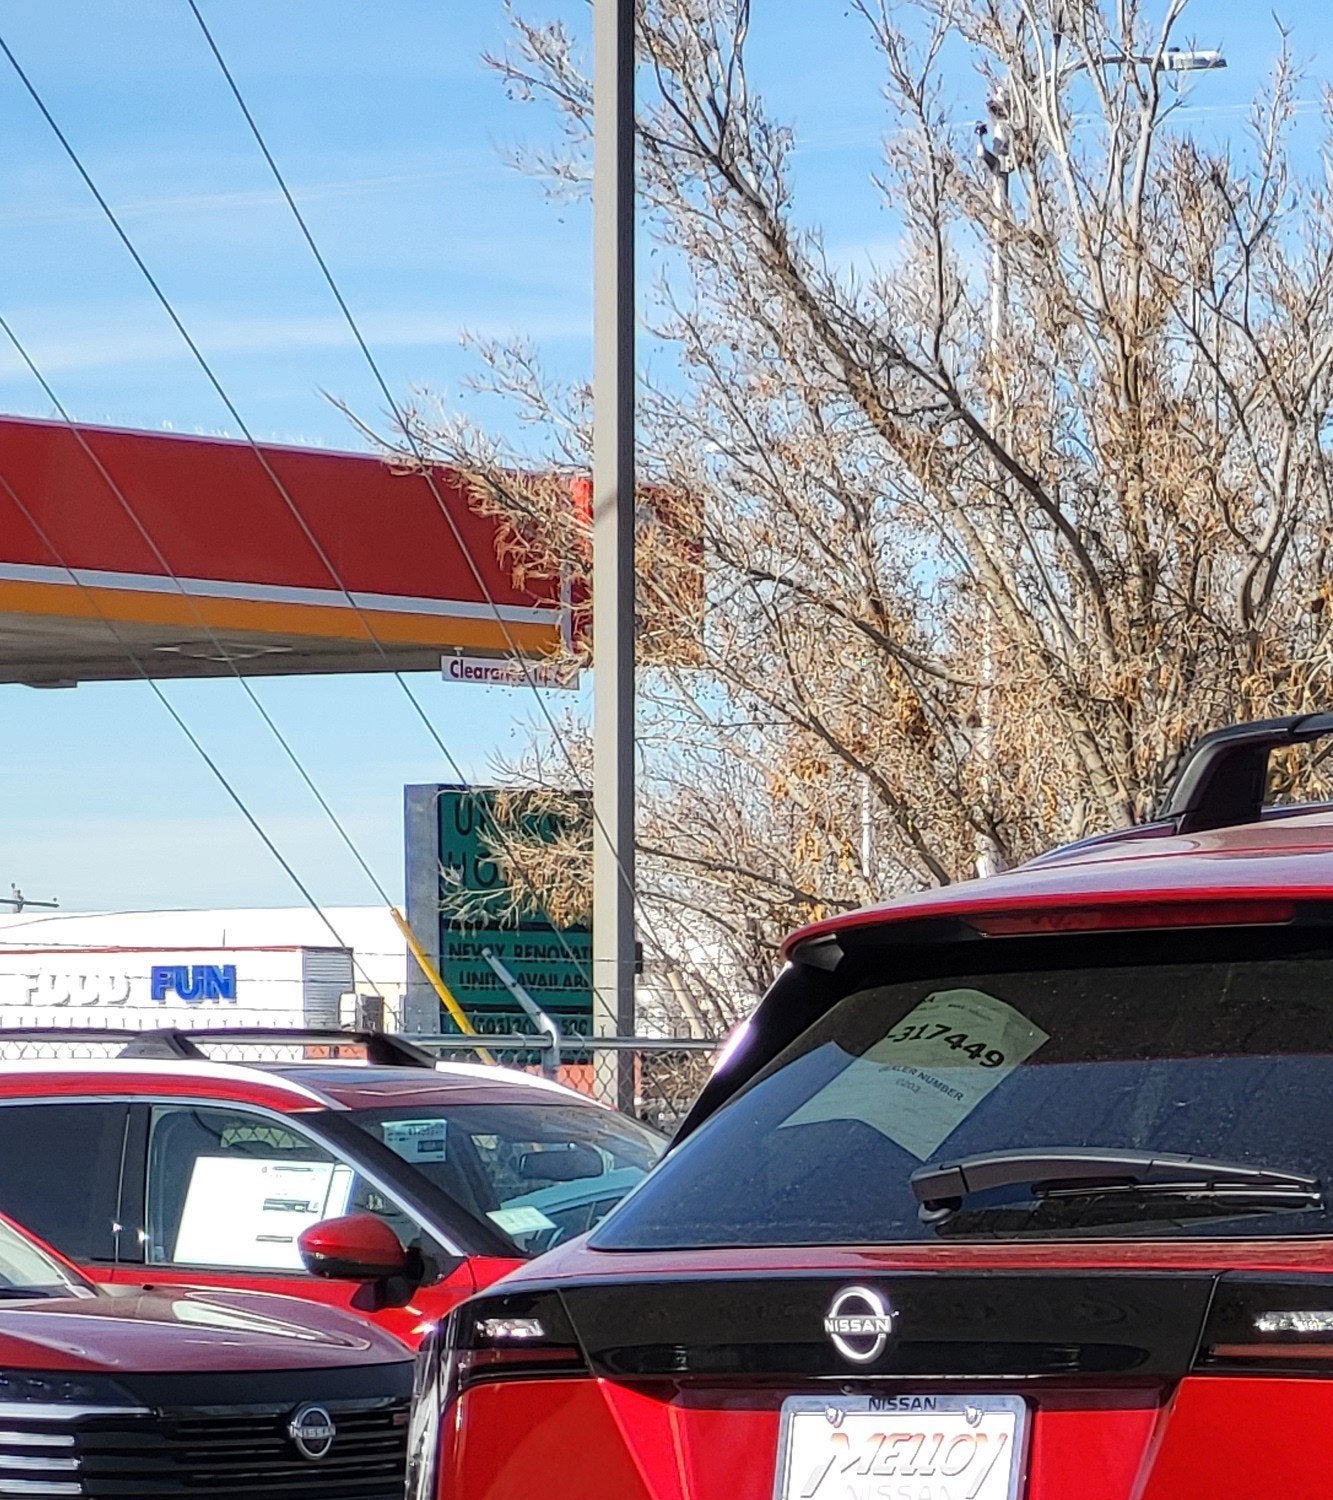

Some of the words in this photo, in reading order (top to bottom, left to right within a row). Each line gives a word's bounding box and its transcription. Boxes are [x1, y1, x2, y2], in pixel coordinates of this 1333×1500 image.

[449, 942, 506, 962] NEWY
[513, 943, 592, 964] RENOVAT
[151, 964, 236, 1005] FUN
[459, 971, 502, 991] UNIT
[916, 1070, 965, 1102] NUMBER
[823, 1318, 892, 1334] NISSAN
[868, 1396, 937, 1411] NISSAN
[291, 1425, 336, 1439] NISSAN
[800, 1431, 1009, 1500] MELLOY
